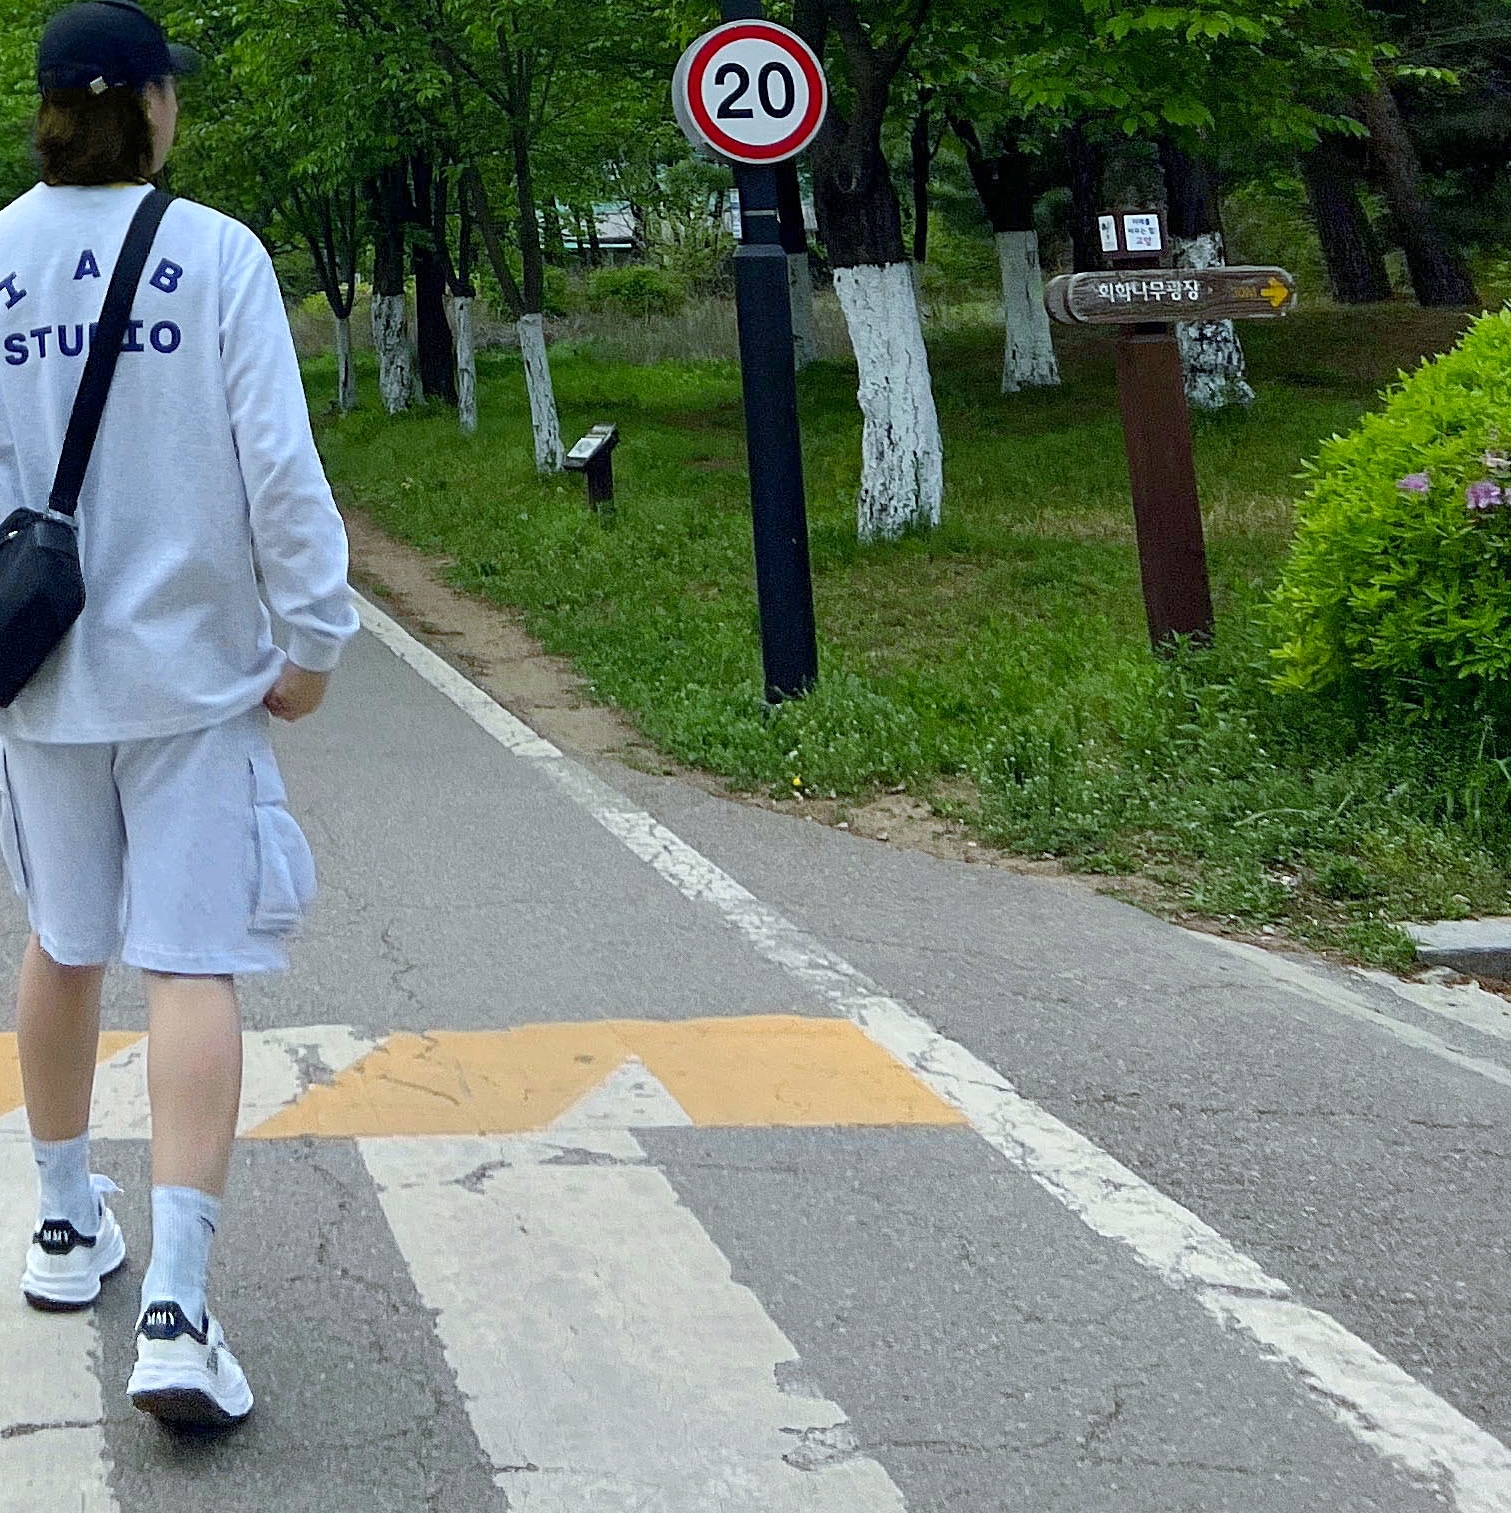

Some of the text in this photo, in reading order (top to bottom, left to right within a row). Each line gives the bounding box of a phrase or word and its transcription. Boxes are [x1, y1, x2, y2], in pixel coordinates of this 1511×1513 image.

[714, 61, 796, 120] 20
[1098, 280, 1199, 303] 회화나무광장
[4, 320, 182, 365] STUIO
